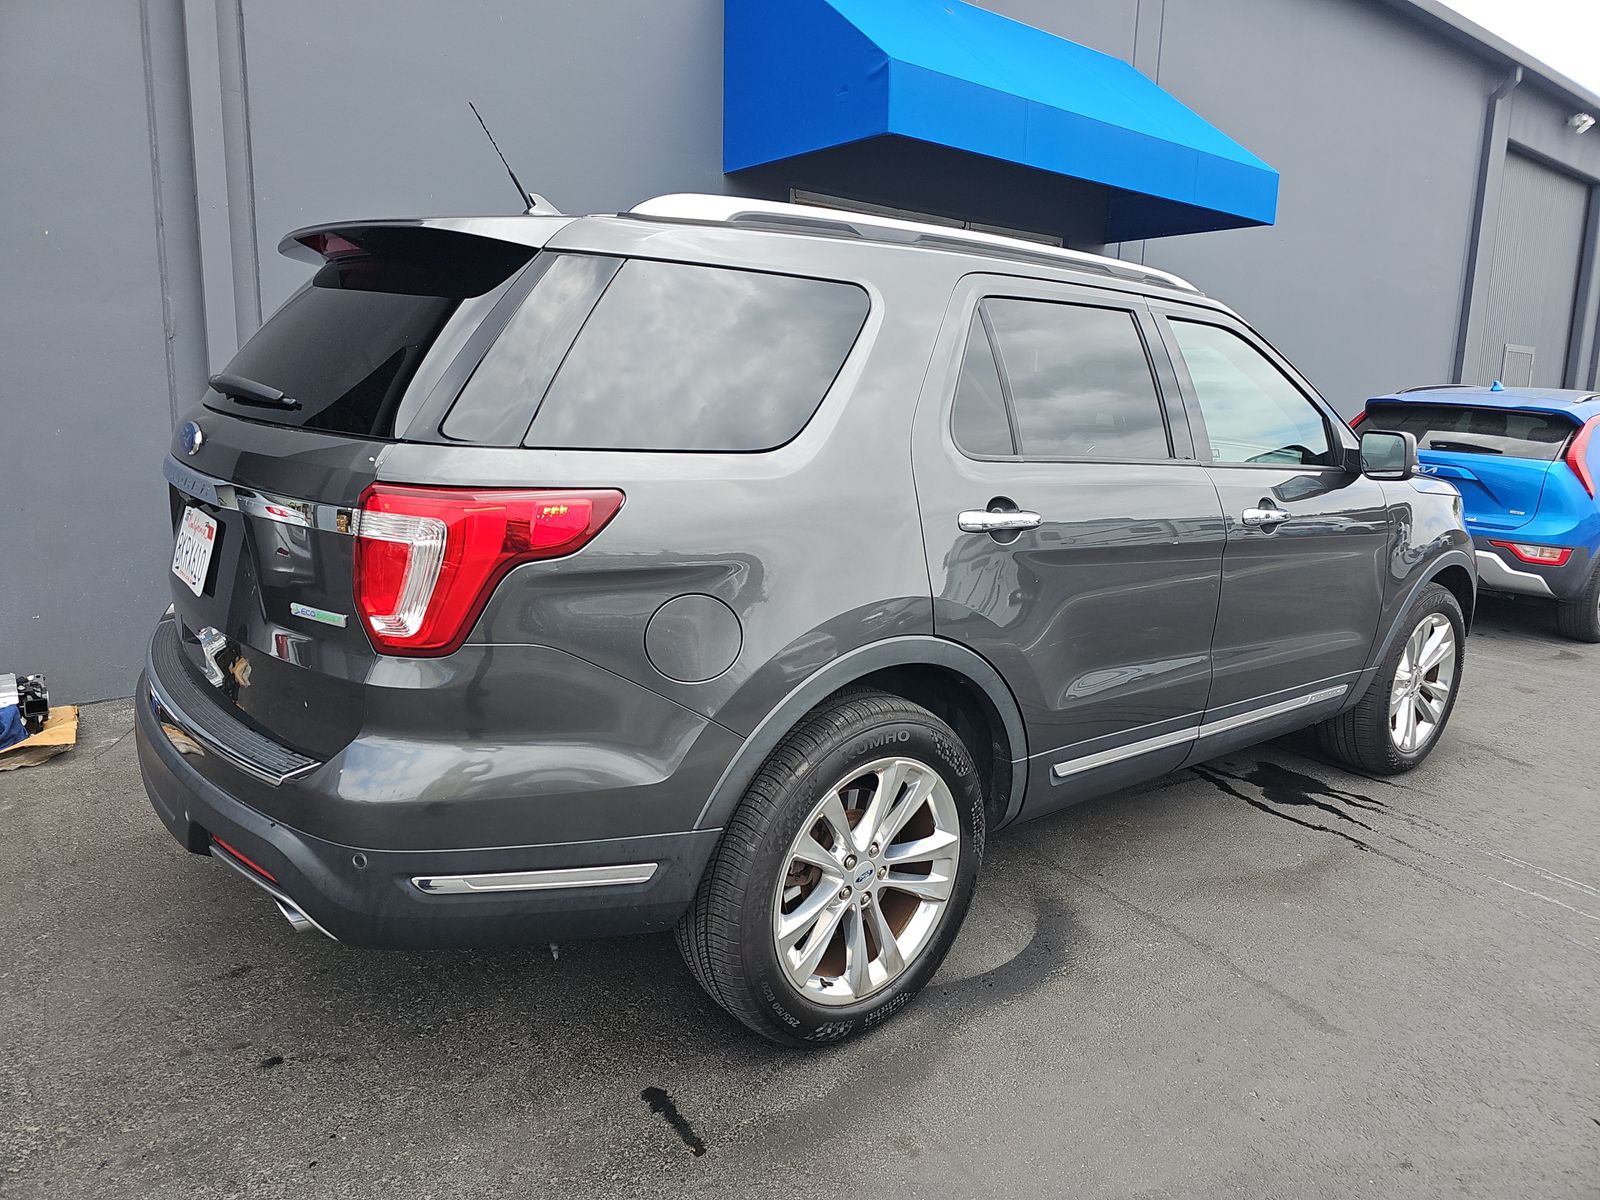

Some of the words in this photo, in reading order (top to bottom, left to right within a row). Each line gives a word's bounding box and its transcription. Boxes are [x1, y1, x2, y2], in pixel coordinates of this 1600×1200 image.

[842, 729, 910, 765] KUMHO
[761, 981, 776, 1002] R20
[772, 1002, 801, 1028] 255/50
